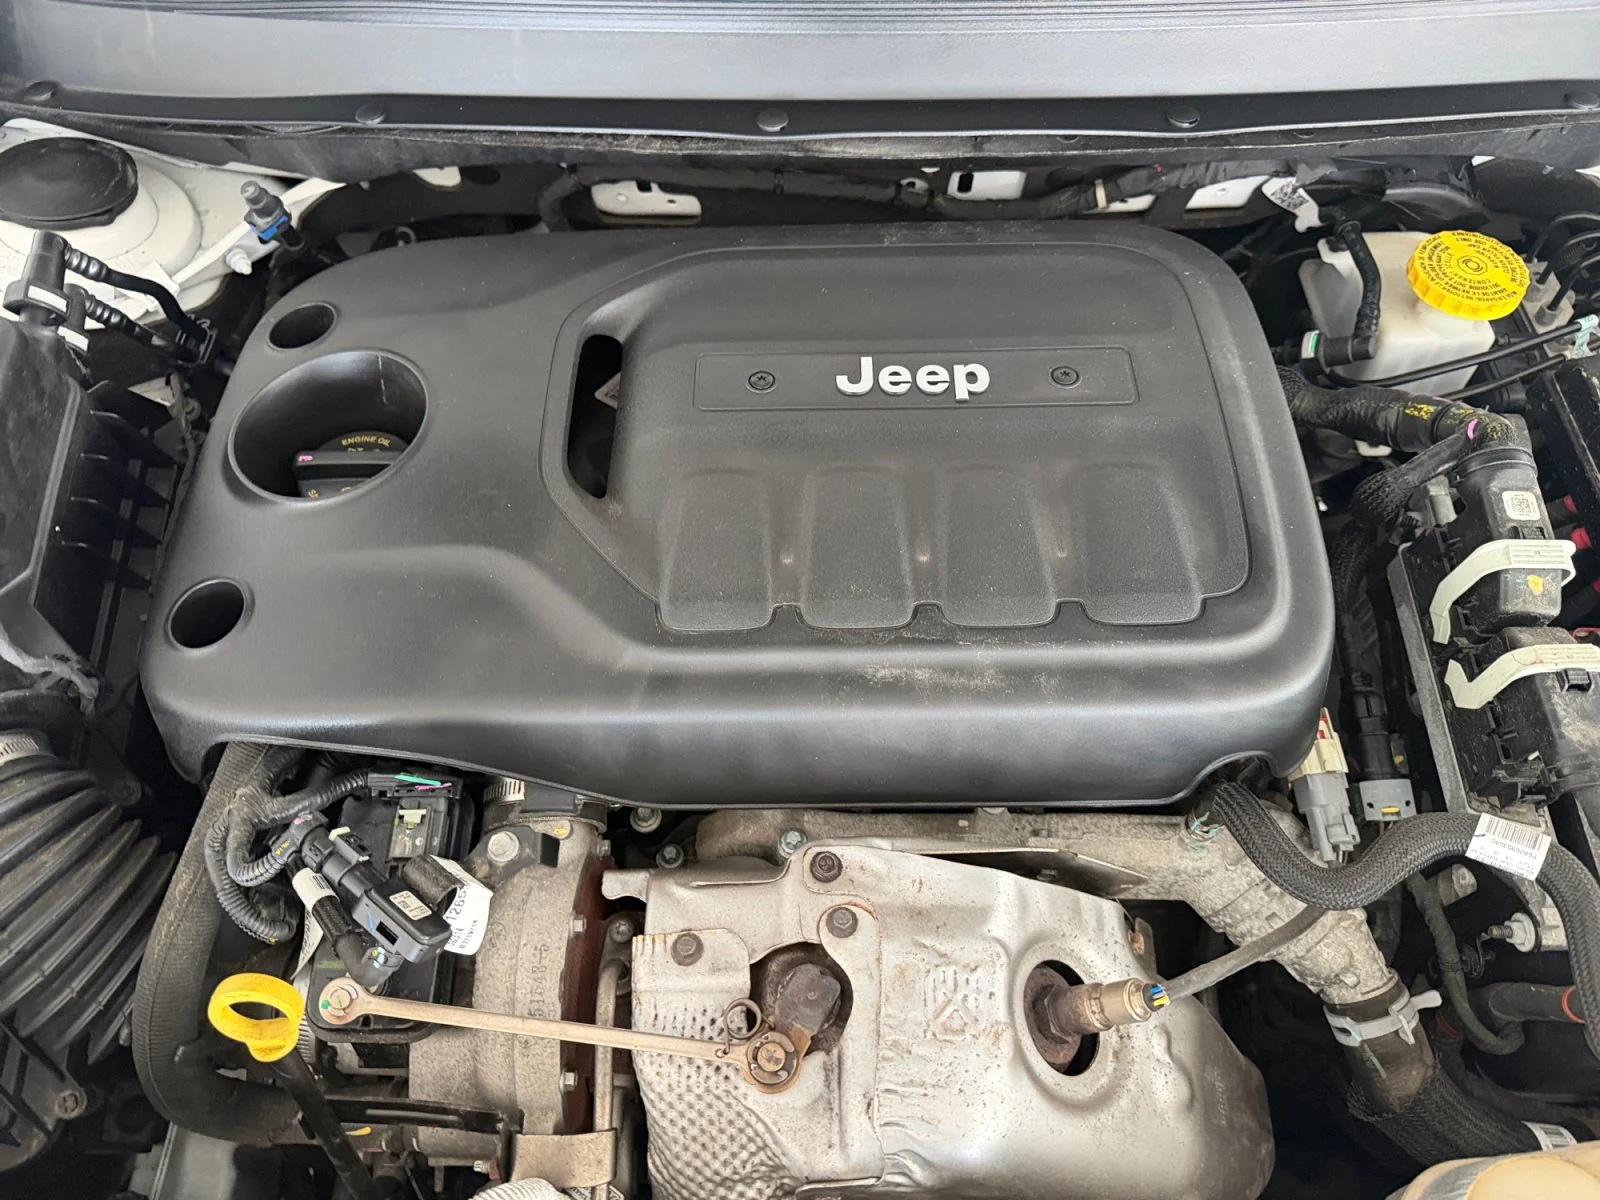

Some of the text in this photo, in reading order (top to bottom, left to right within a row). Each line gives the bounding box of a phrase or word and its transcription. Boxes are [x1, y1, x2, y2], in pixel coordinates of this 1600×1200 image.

[835, 356, 990, 401] Jeep
[341, 435, 391, 447] ENGINE OIL
